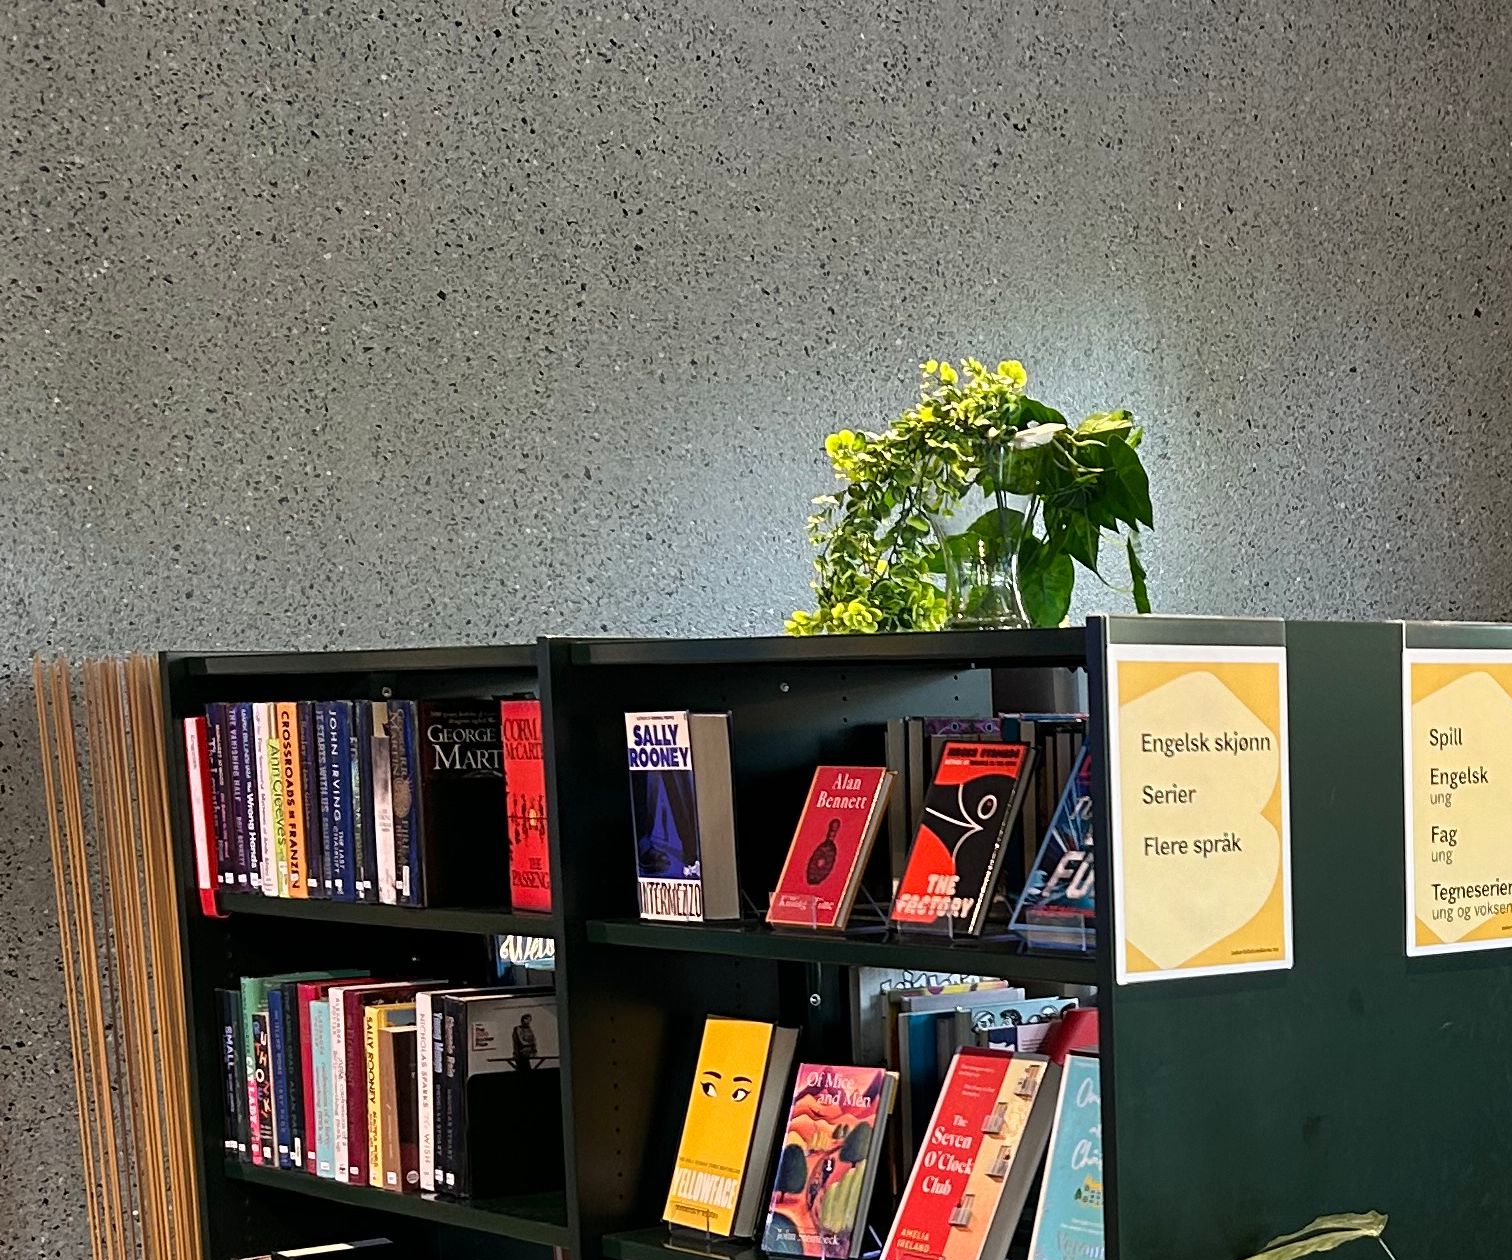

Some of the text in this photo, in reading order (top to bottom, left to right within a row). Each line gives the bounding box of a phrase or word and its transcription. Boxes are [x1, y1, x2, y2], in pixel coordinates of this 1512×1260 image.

[427, 724, 496, 743] GEORGE
[633, 724, 679, 746] SALLY
[1141, 731, 1271, 757] Engelsk skjønn
[1429, 726, 1463, 751] Spill
[282, 711, 295, 806] CROSSROADS
[329, 710, 342, 821] JOHN IRVING
[628, 747, 690, 768] ROONEY
[832, 773, 862, 790] Alan
[1430, 766, 1489, 790] Engelsk
[269, 744, 287, 845] Ann Cleeves
[816, 791, 868, 809] Bennett
[1141, 785, 1197, 805] Serier
[1430, 791, 1452, 808] ung
[247, 793, 255, 830] Wrong
[1144, 833, 1242, 858] Flere språk
[1430, 826, 1458, 847] Fag
[249, 832, 258, 869] Hands
[1431, 849, 1453, 865] ung
[927, 874, 960, 896] THE
[639, 881, 702, 917] INTERMEZZO
[895, 893, 975, 918] FACTORY
[1432, 900, 1512, 921] ung og voksen
[366, 1017, 375, 1048] SALLY
[419, 1013, 428, 1067] NICHOLAS
[224, 1026, 235, 1070] SMALL
[368, 1052, 377, 1104] ROONEY
[421, 1071, 429, 1107] SPARKS
[806, 1072, 855, 1089] Of Mice
[817, 1091, 871, 1108] and Men
[953, 1114, 969, 1127] The
[424, 1134, 432, 1164] WISH
[931, 1126, 973, 1149] Seven
[924, 1150, 973, 1175] O'Clock
[672, 1167, 739, 1209] YELLOWFACE
[922, 1175, 953, 1195] Club
[896, 1238, 931, 1254] IRELAND
[900, 1229, 930, 1241] AMELIA
